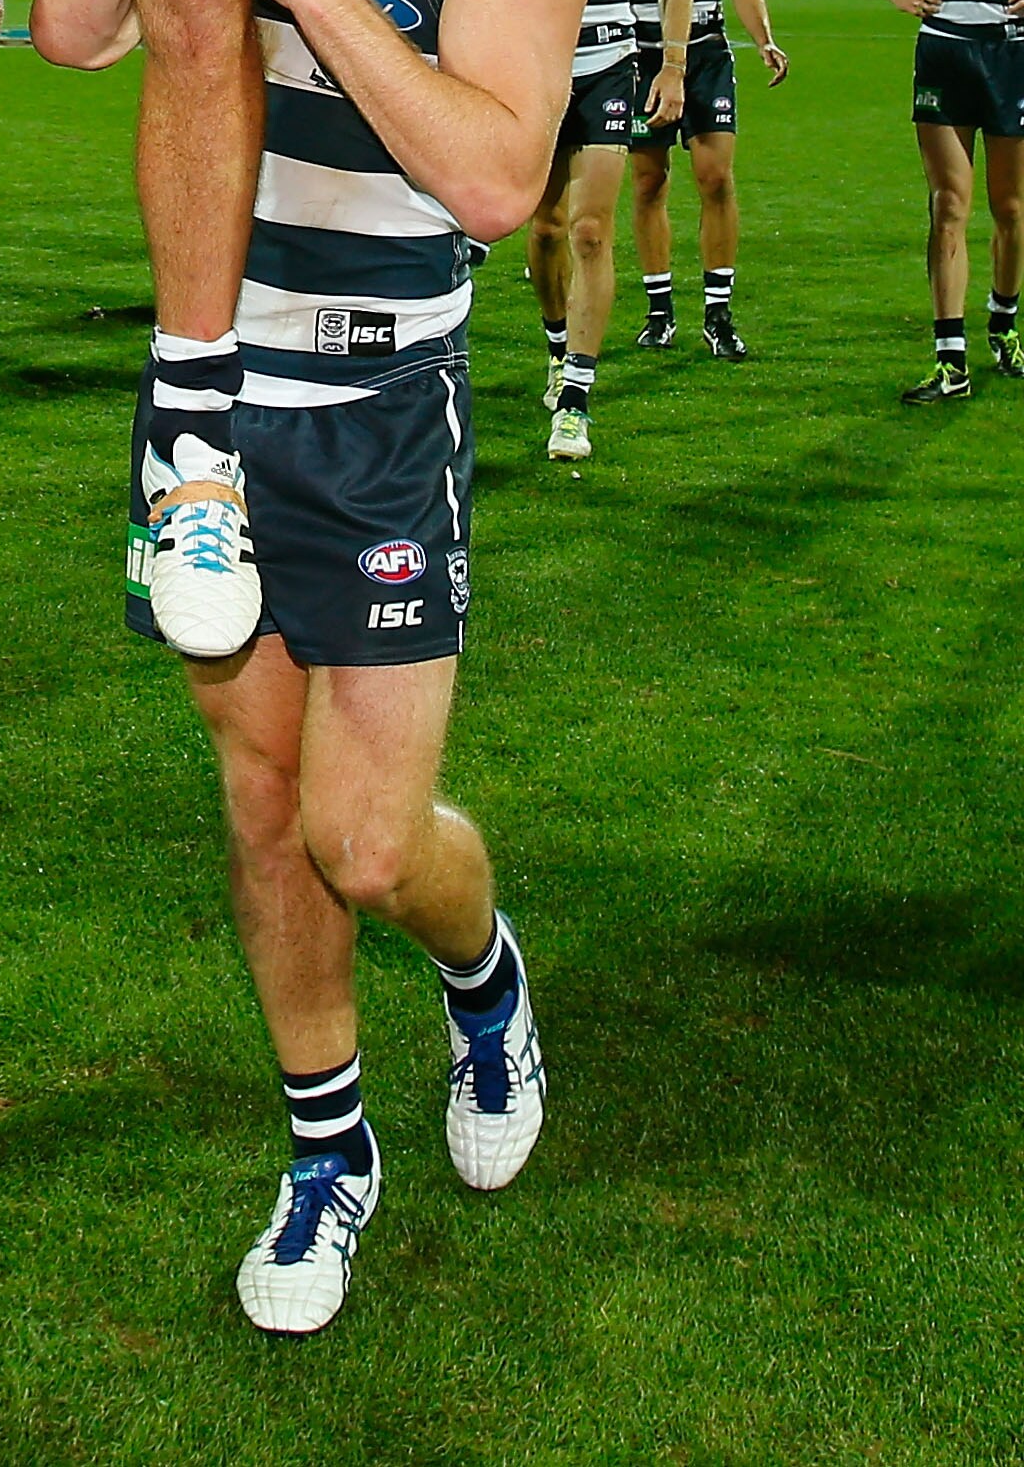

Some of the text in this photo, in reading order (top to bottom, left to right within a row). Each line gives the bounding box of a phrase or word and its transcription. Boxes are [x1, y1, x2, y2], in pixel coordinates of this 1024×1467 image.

[606, 102, 626, 112] AFL
[605, 120, 626, 131] ISC
[716, 114, 731, 123] ISC
[350, 326, 392, 343] ISC
[367, 550, 422, 574] AFL
[367, 600, 424, 628] ISC
